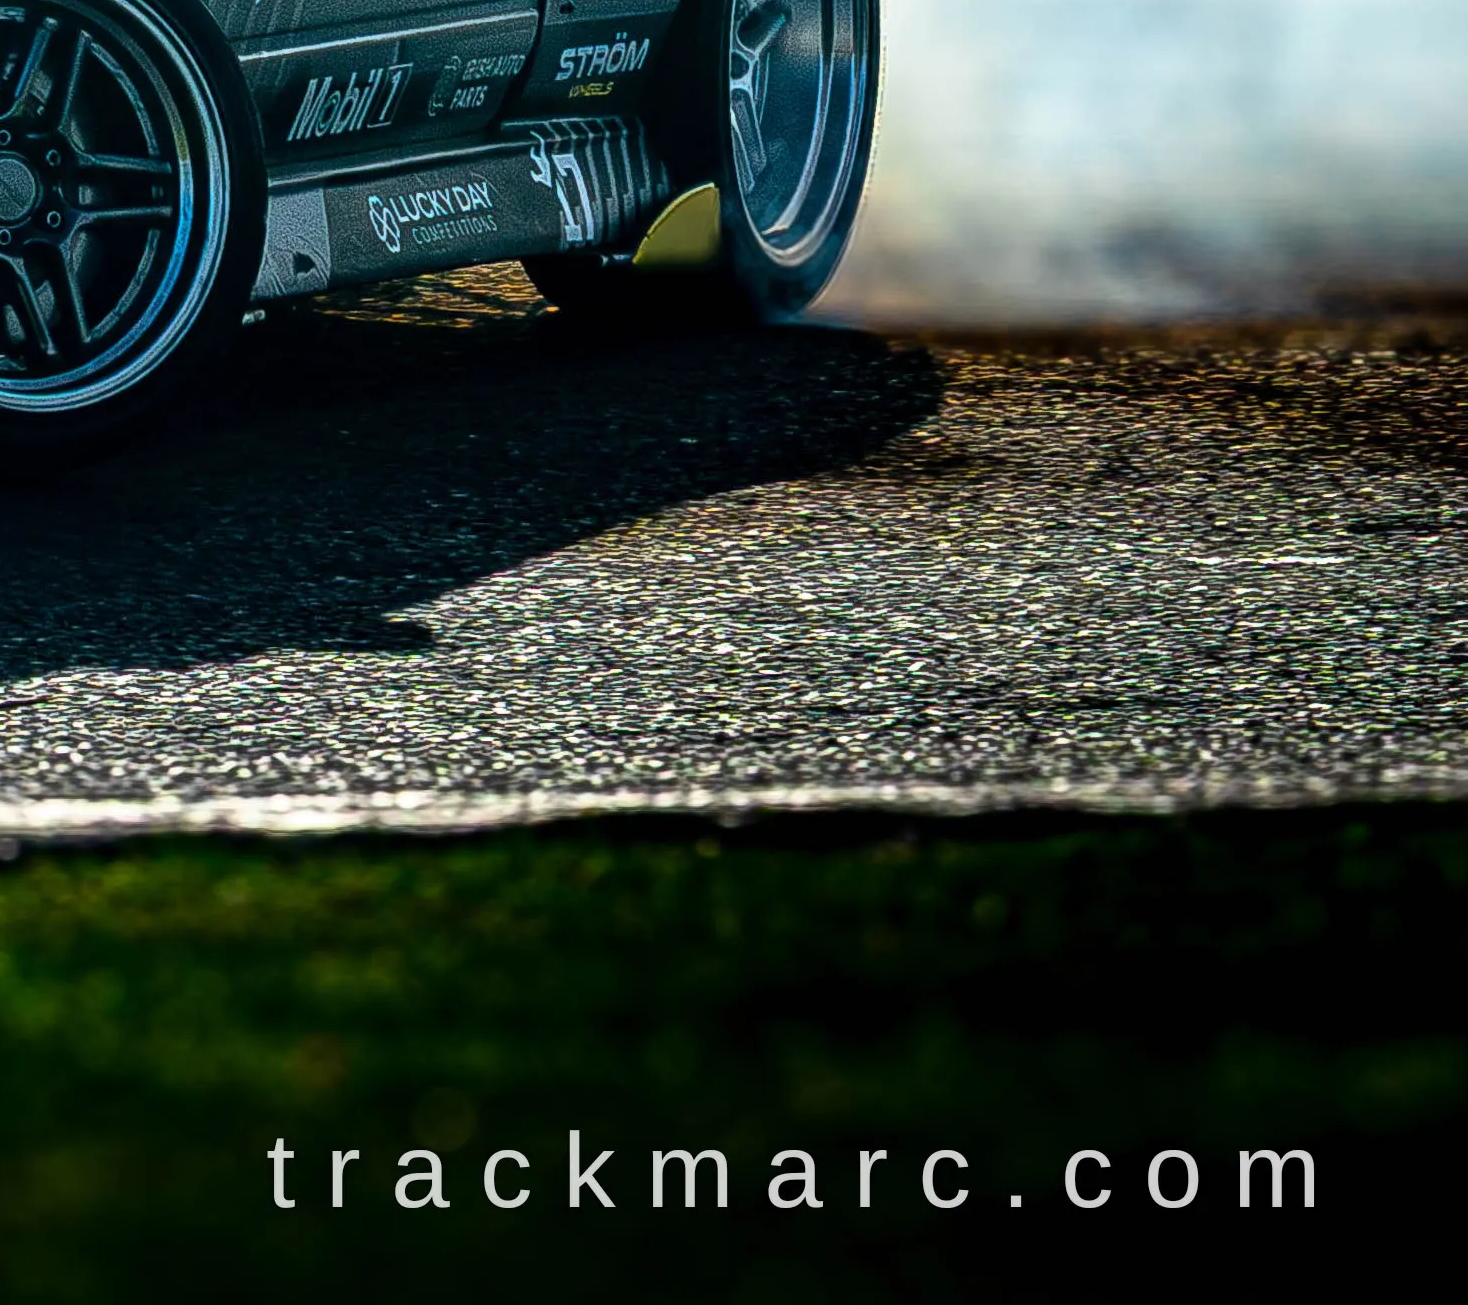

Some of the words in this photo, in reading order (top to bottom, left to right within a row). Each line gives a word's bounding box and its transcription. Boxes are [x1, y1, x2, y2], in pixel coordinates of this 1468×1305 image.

[554, 31, 650, 81] STRÖM
[287, 68, 384, 142] Mobil
[411, 214, 498, 245] COMPETITIONS
